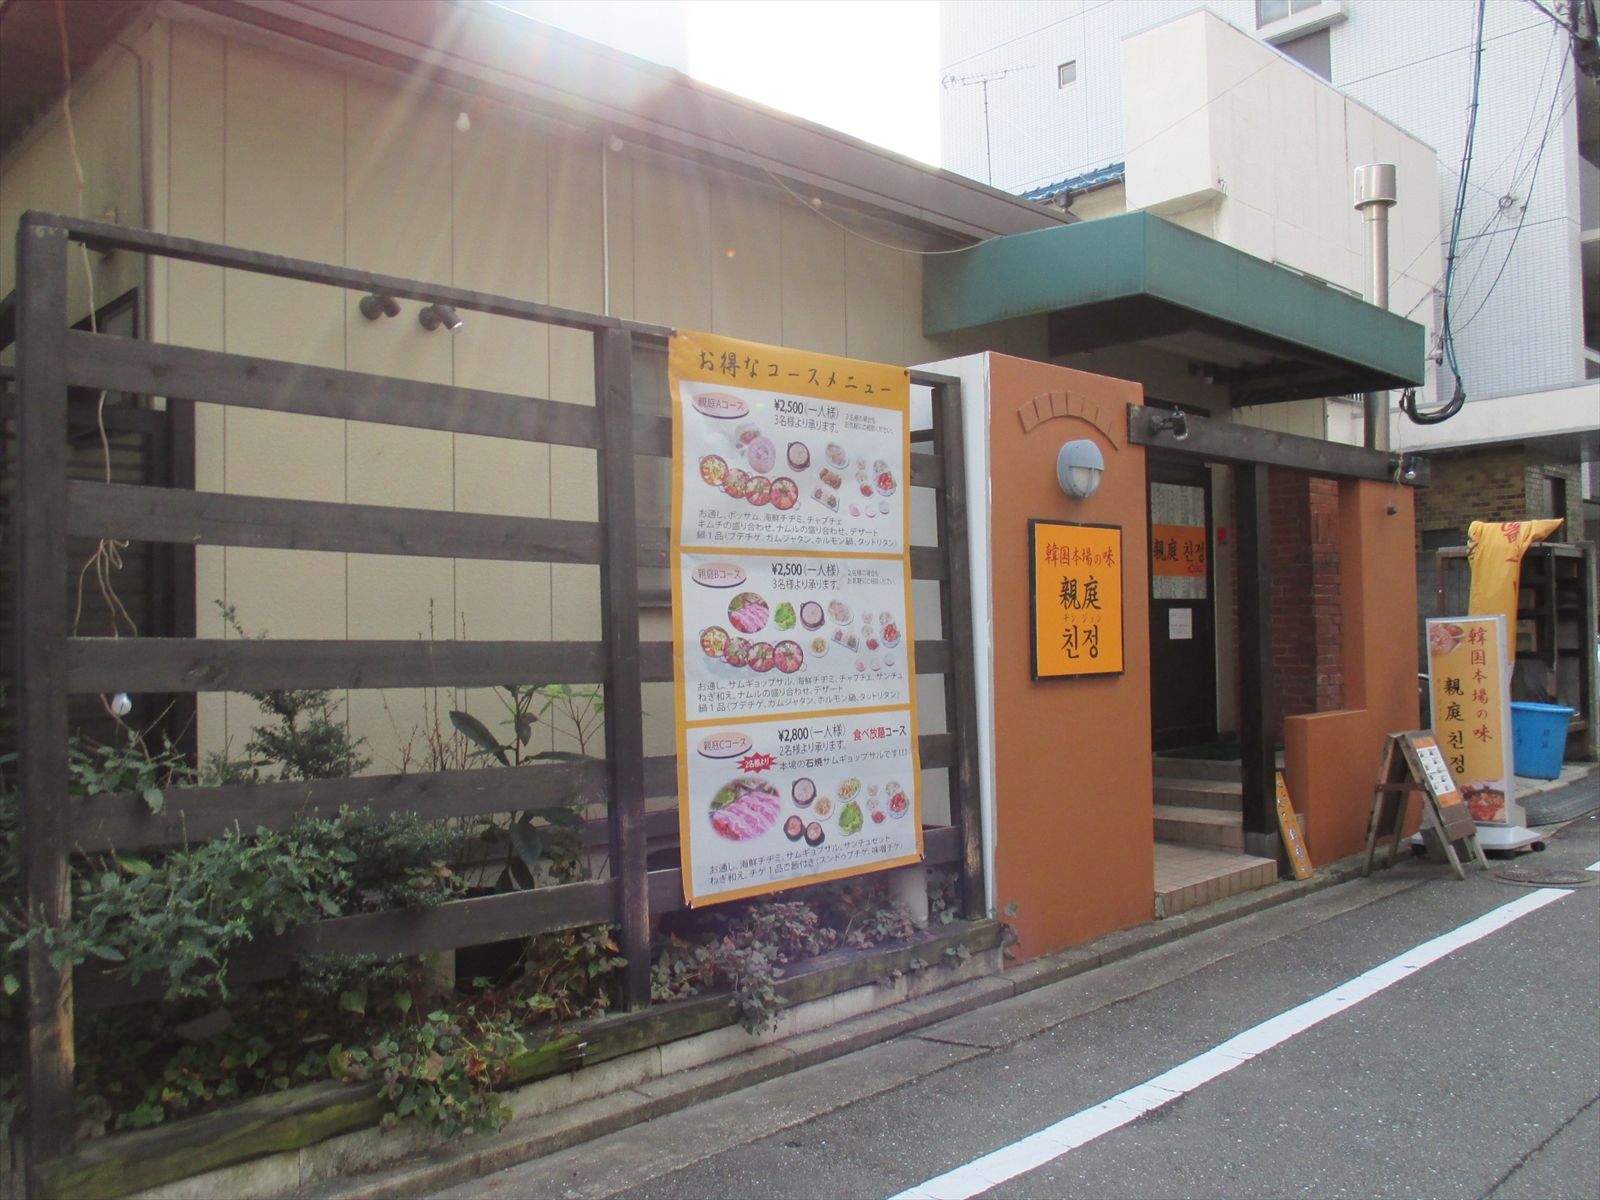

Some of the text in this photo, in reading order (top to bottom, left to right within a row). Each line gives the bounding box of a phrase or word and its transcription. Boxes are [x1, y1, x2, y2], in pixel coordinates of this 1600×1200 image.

[699, 351, 892, 394] お得なコースメニュー
[774, 414, 839, 434] 3名様より承ります。
[1045, 541, 1115, 567] 韓国本場の味
[1154, 538, 1205, 563] 親庭 친정
[773, 578, 840, 591] 3名様より承ります。
[1059, 575, 1102, 610] 親庭
[1061, 624, 1099, 659] 친정
[1467, 627, 1493, 743] 韓国本場の味
[853, 725, 907, 741] 食べ放題コース
[1444, 677, 1465, 775] 親庭 친정
[779, 740, 846, 757] 2名様より承ります。
